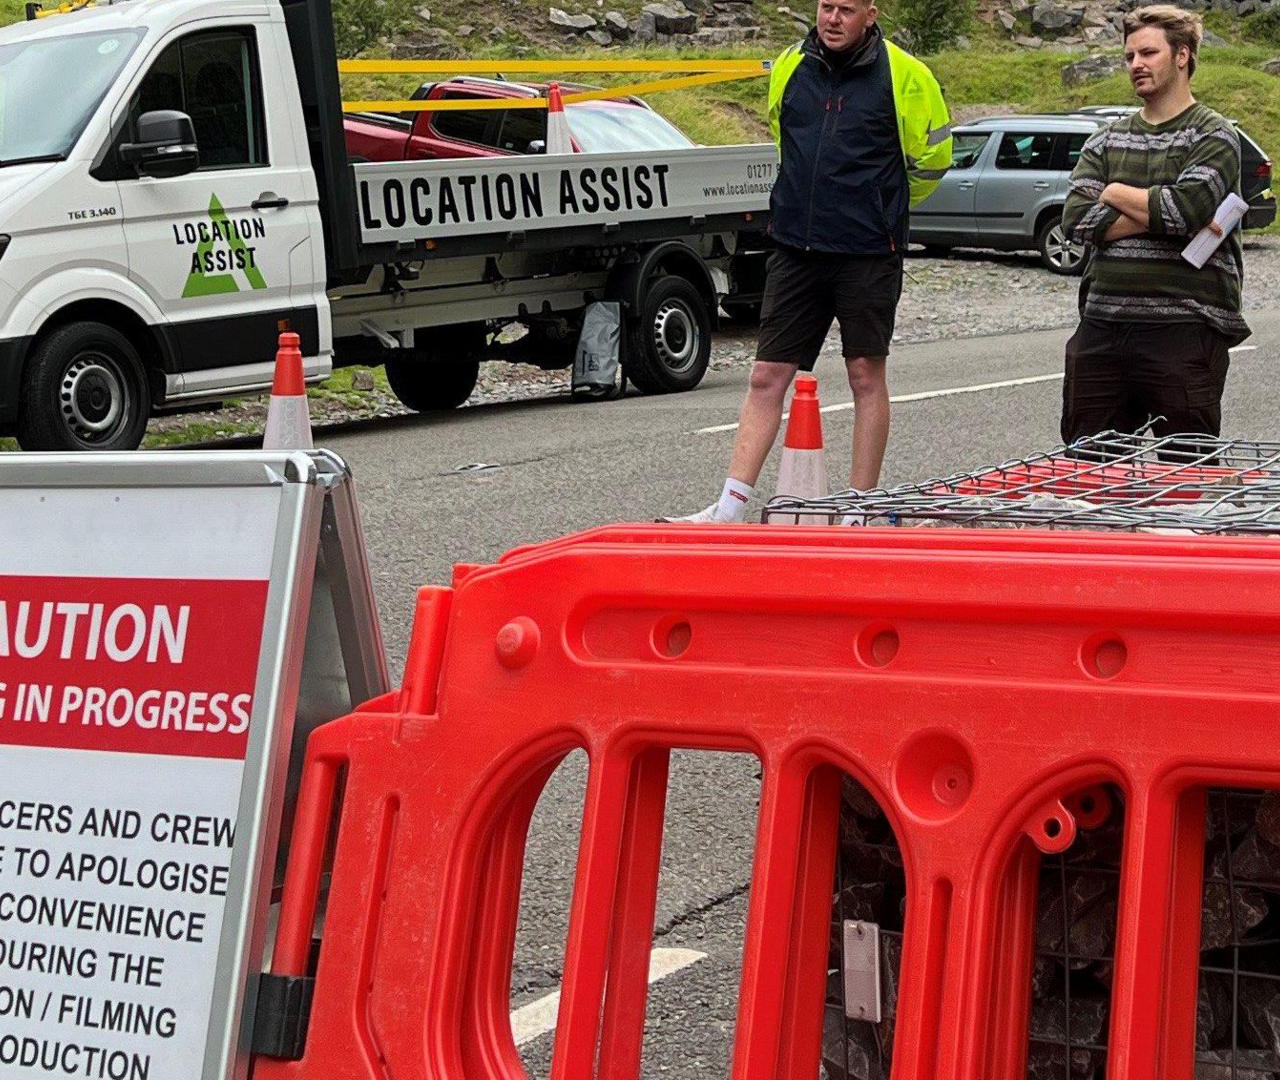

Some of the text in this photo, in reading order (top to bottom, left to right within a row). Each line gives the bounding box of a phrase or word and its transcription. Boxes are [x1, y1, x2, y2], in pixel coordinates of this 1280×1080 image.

[747, 164, 772, 178] 01277
[68, 207, 116, 220] TGE 3.140
[360, 164, 669, 229] LOCATION ASSIST
[172, 217, 265, 245] LOCATION
[191, 247, 257, 273] ASSIST
[13, 684, 52, 723] IN
[59, 686, 252, 735] PROGRESS
[79, 807, 141, 840] AND
[151, 812, 237, 848] CREW
[14, 847, 51, 878] TO
[57, 852, 229, 896] APOLOGISE
[108, 954, 164, 987] THE
[40, 992, 53, 1021] /
[58, 994, 177, 1038] FILMING
